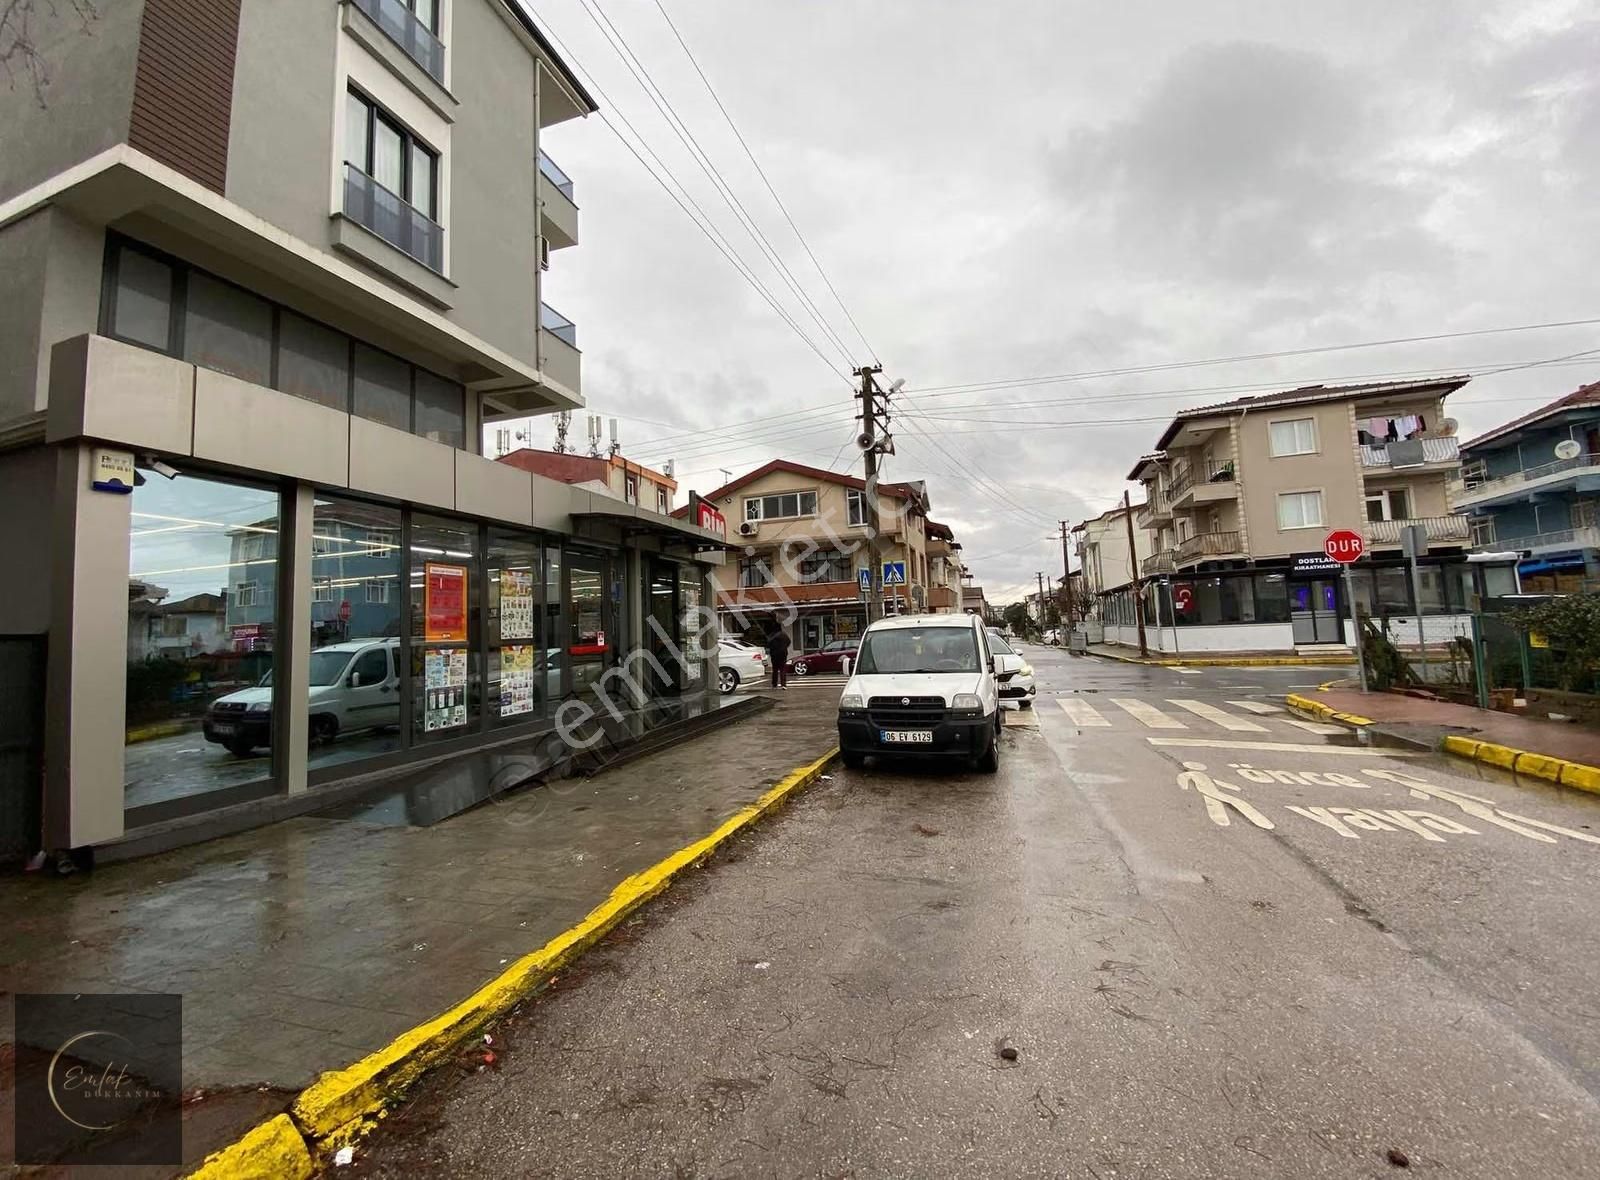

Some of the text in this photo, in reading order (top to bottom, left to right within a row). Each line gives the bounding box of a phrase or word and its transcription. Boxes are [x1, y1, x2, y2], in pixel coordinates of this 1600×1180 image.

[1328, 539, 1361, 553] DUR
[886, 732, 896, 741] 06
[912, 732, 931, 742] 6129
[1284, 806, 1481, 842] yaya
